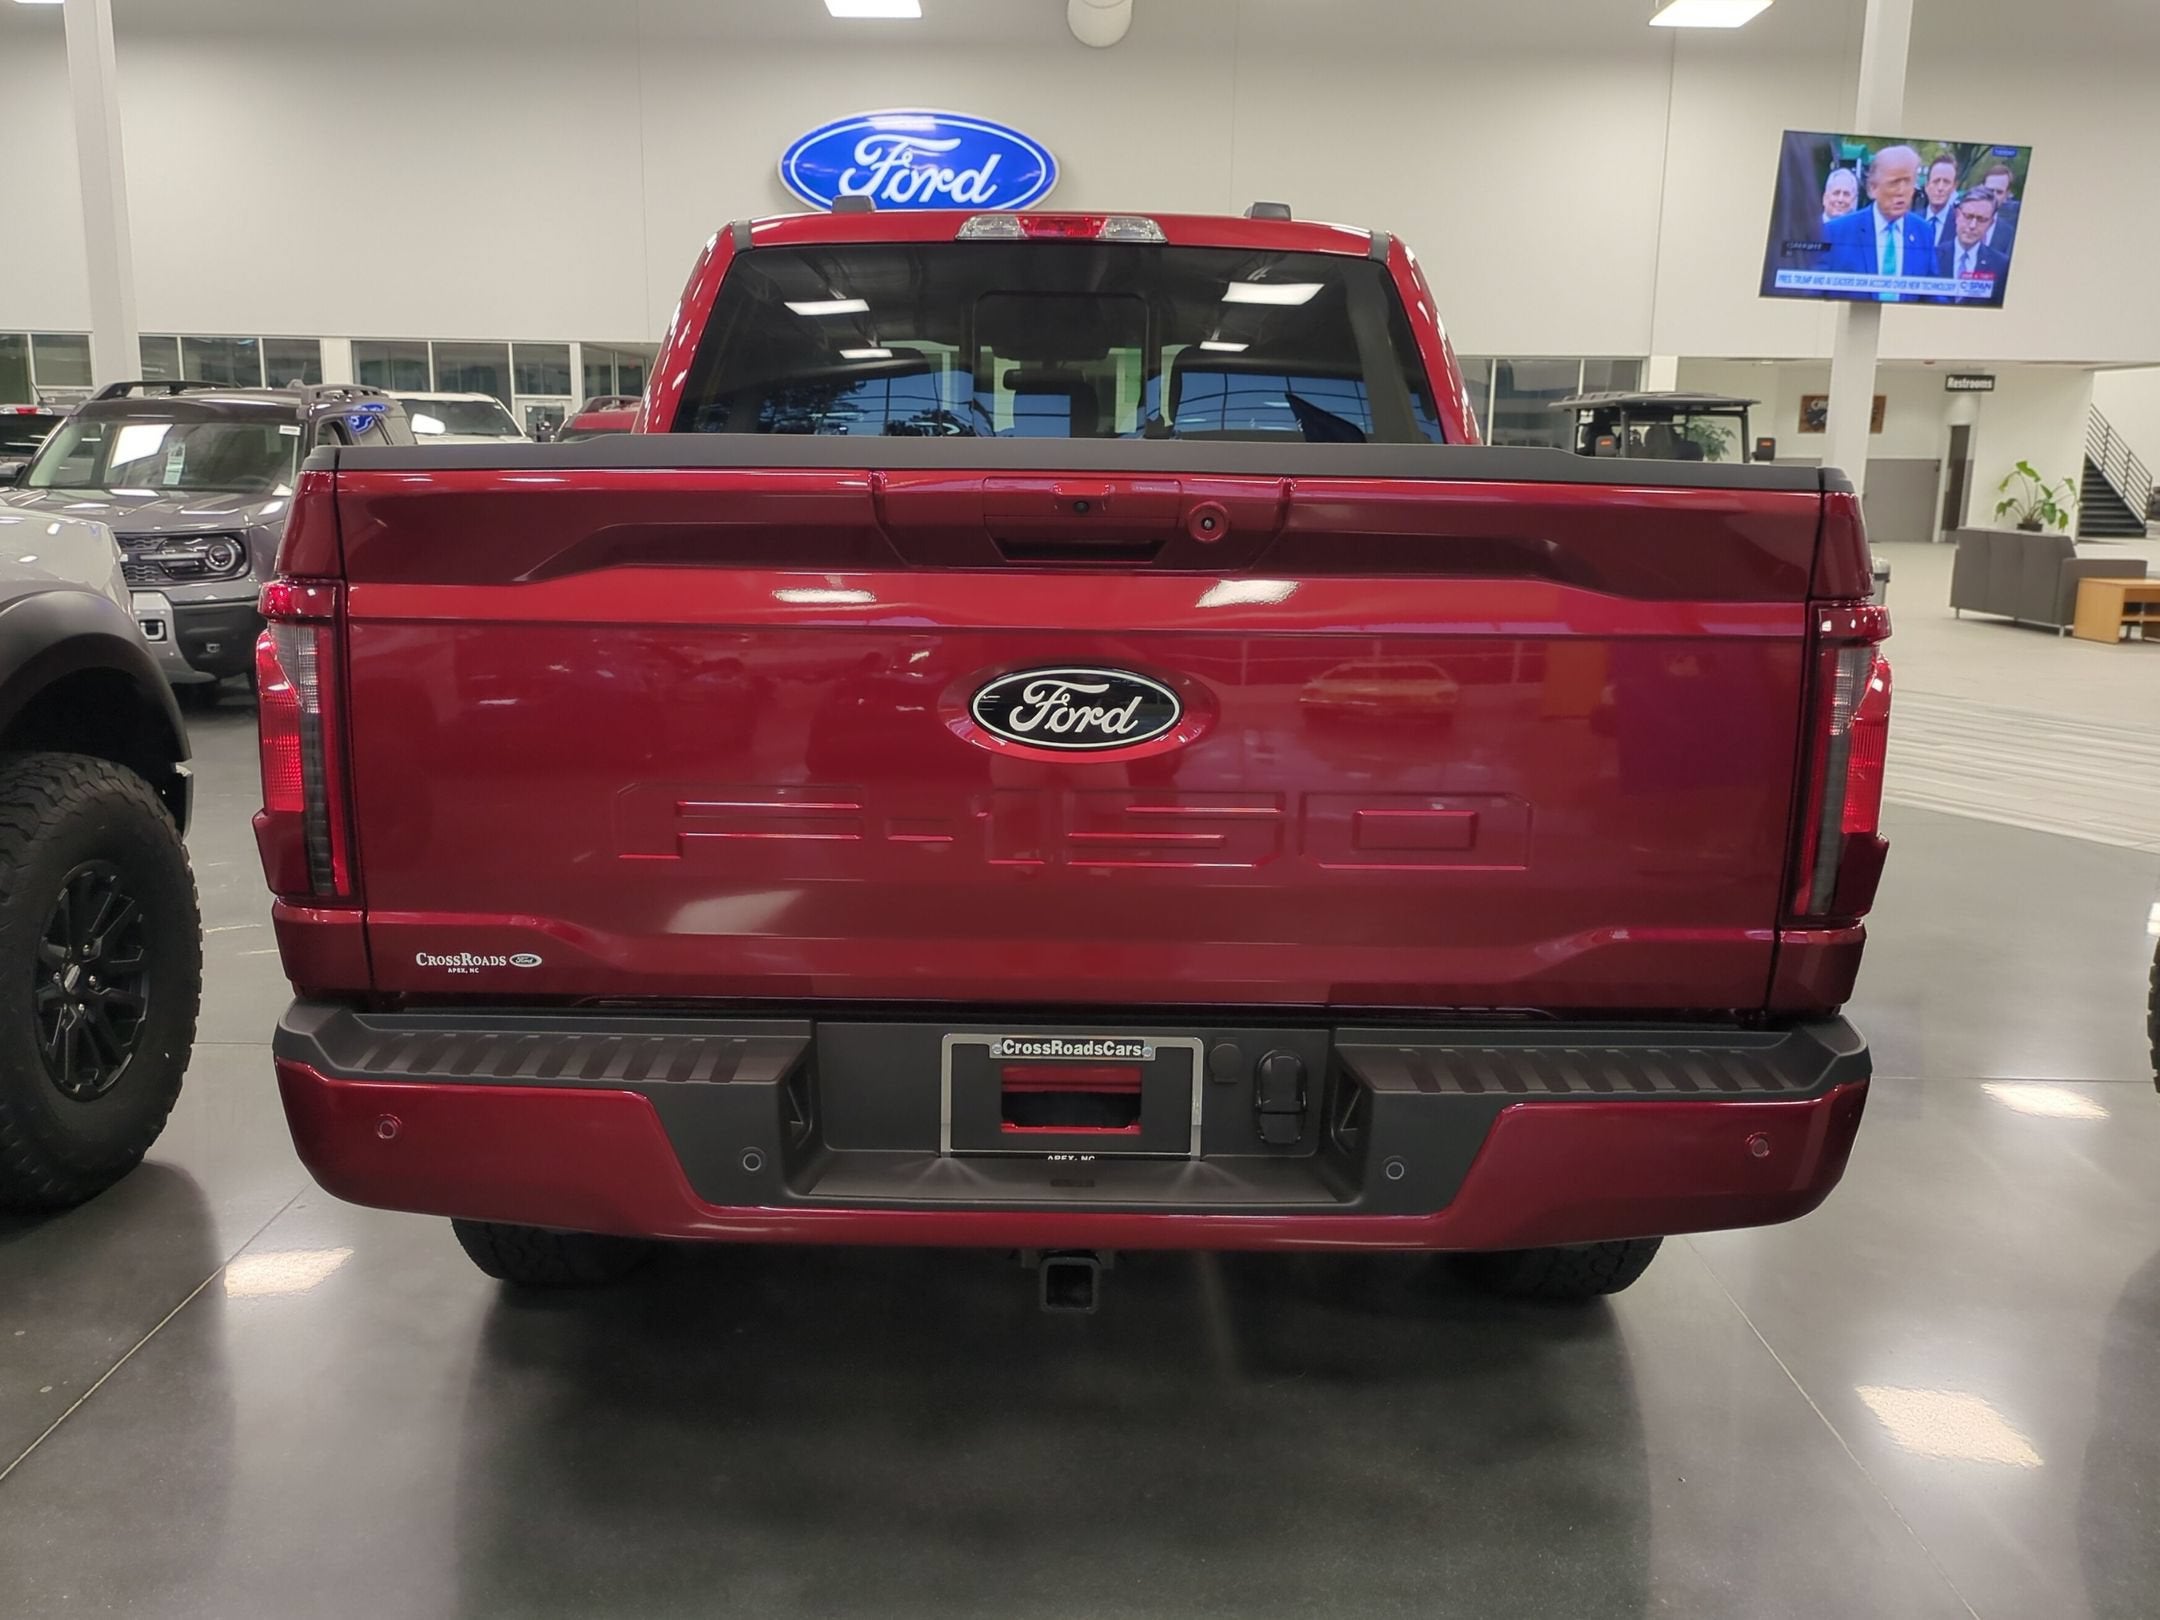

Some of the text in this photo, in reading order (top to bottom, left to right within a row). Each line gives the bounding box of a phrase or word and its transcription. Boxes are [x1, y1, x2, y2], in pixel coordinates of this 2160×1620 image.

[839, 134, 1001, 204] Ford
[1947, 377, 1992, 389] Restrooms
[1009, 679, 1143, 734] Ford
[1001, 1039, 1143, 1057] CrossRoadsCars
